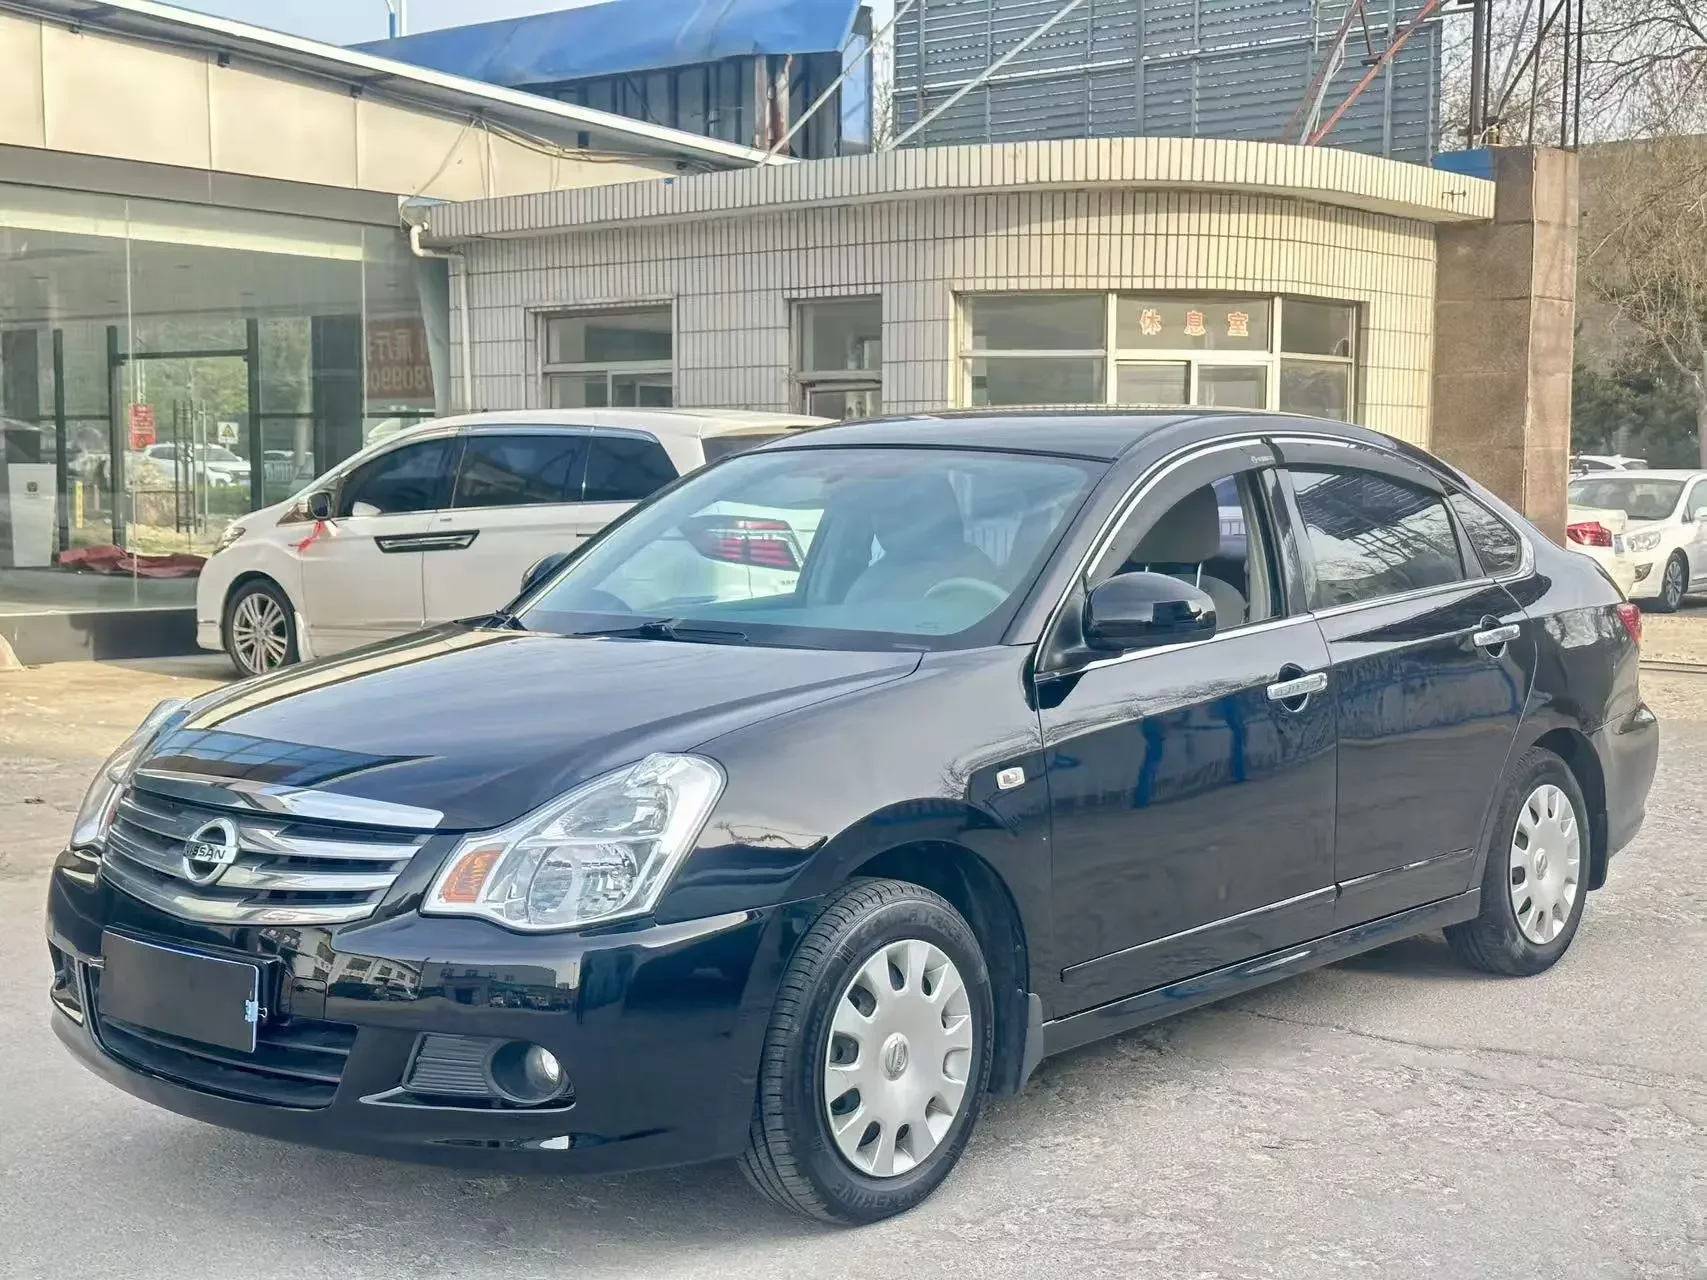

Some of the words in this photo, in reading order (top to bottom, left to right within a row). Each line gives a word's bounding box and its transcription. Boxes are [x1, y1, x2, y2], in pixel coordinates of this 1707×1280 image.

[1139, 307, 1249, 337] 休息室
[184, 842, 226, 861] NISSAN
